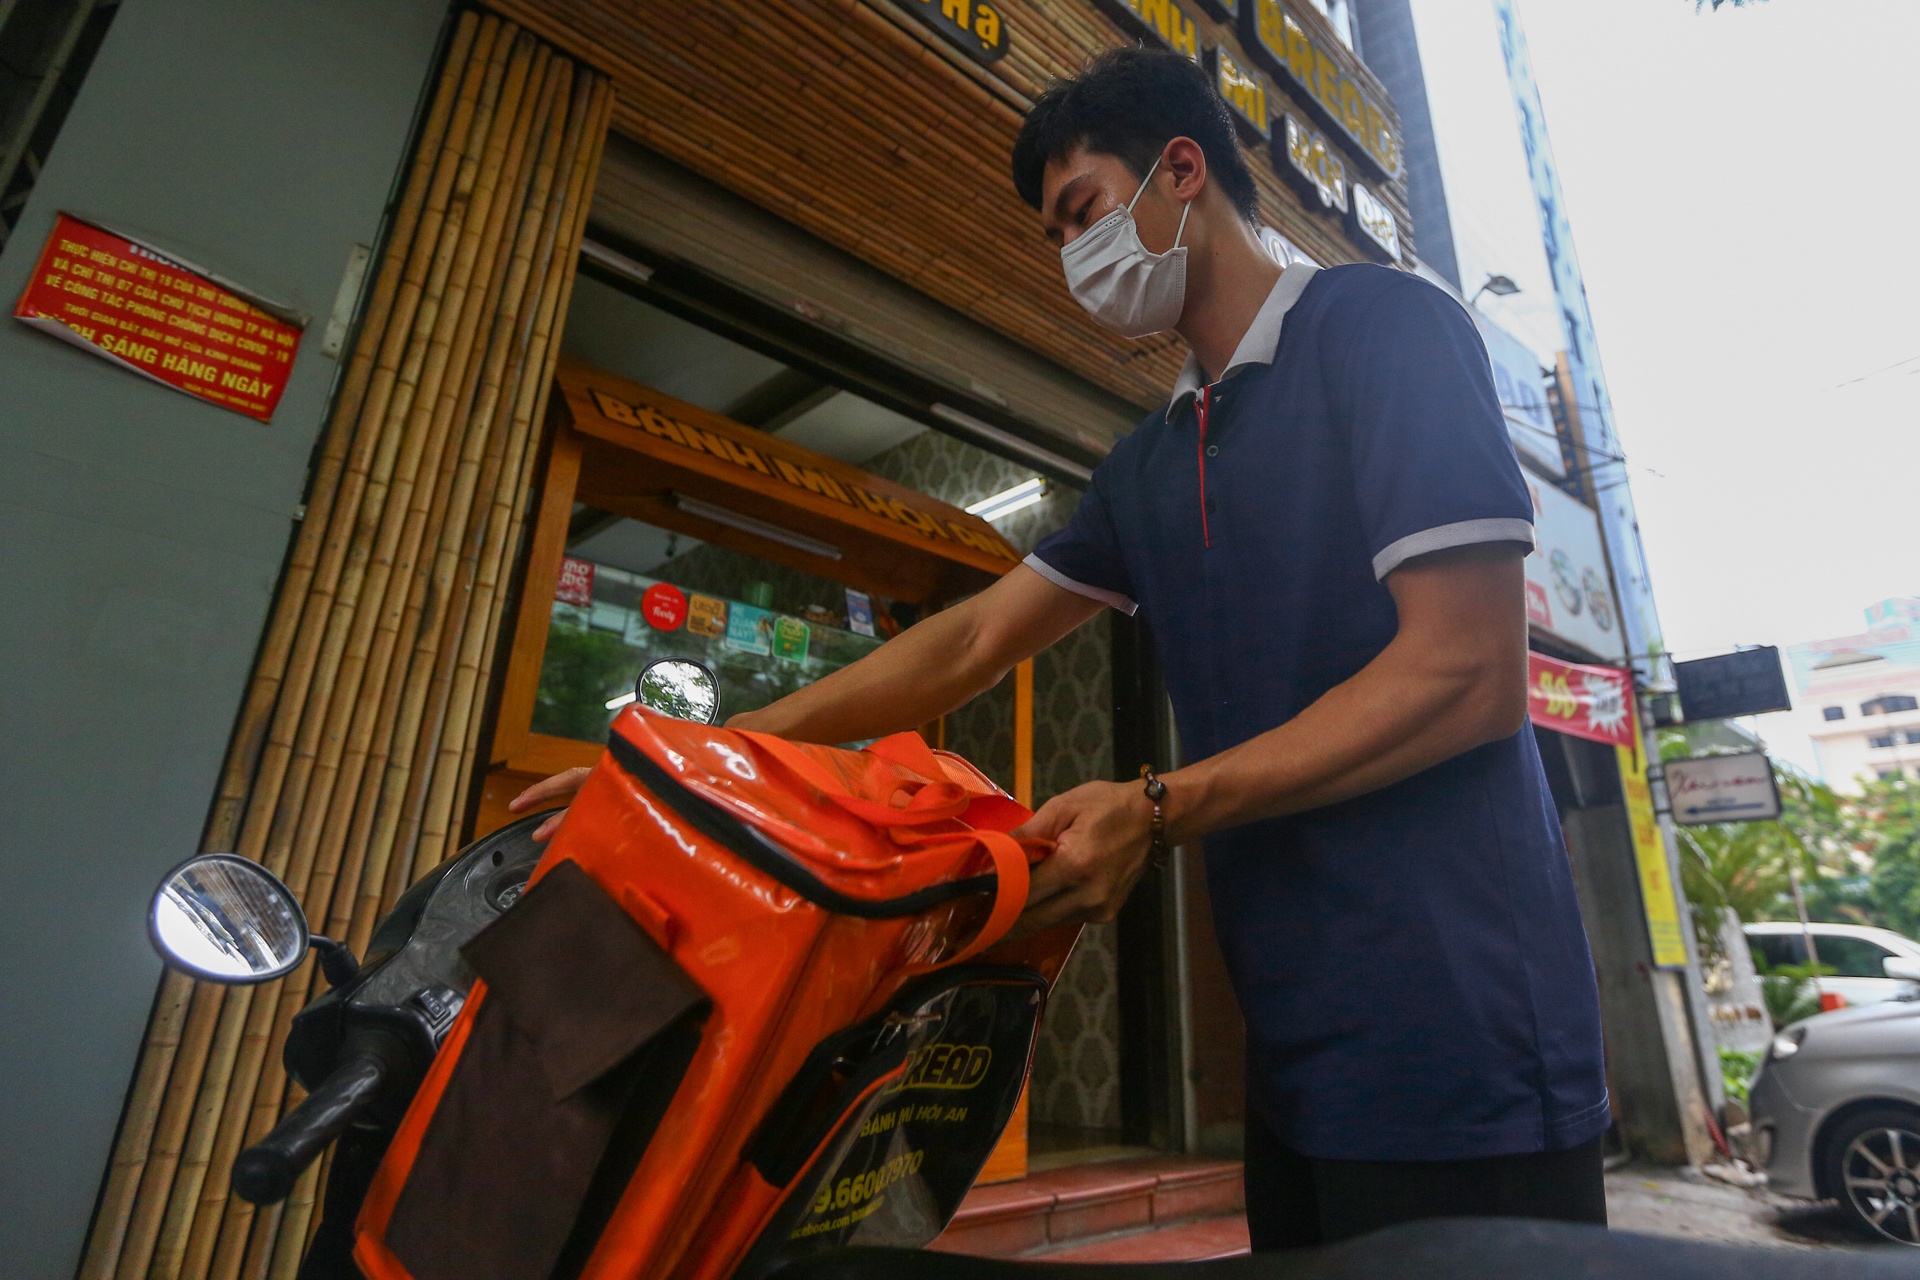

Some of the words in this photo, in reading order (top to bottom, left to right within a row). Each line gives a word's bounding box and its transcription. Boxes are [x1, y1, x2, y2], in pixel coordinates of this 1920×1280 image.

[1257, 0, 1399, 174] BREAD
[588, 387, 776, 478] BÁNH
[944, 1106, 969, 1122] AN
